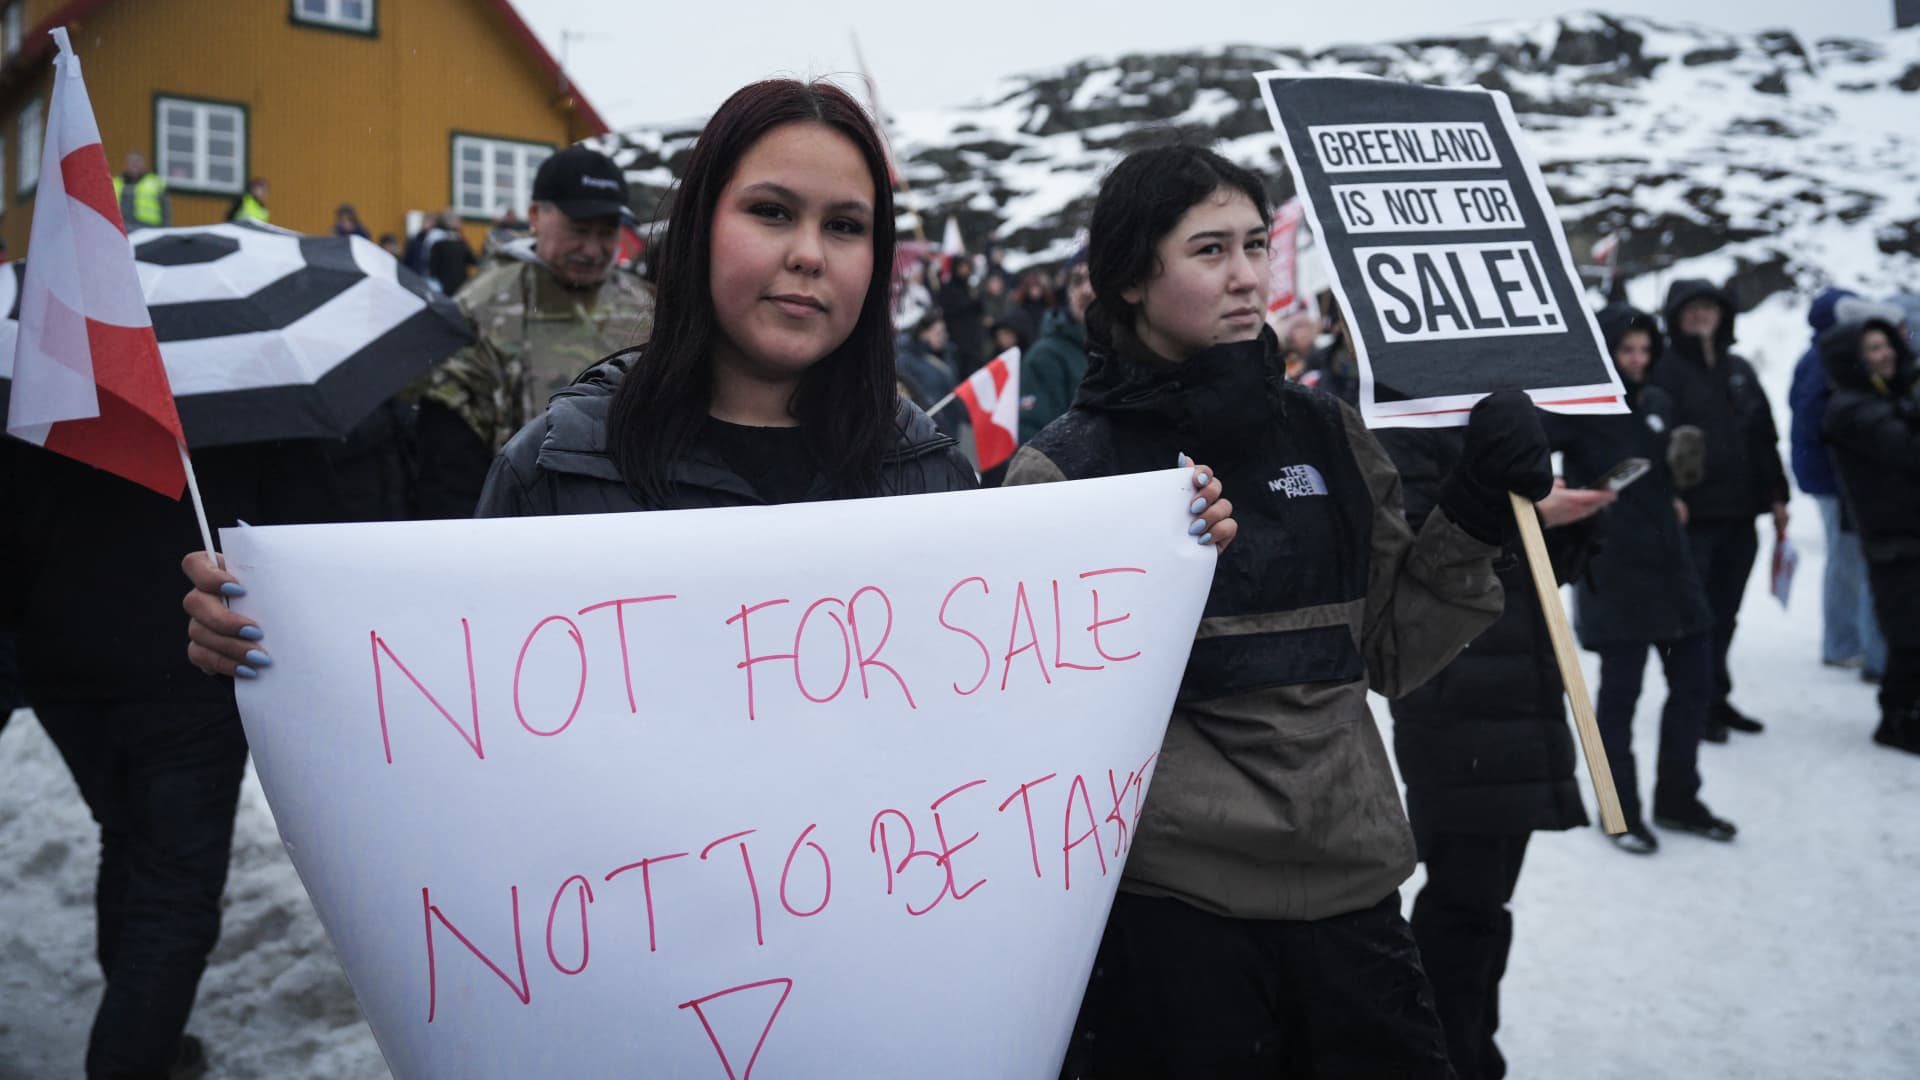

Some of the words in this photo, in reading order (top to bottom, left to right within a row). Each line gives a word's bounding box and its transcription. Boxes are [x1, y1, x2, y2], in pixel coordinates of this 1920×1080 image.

[1318, 128, 1492, 166] GREENLAND
[1339, 190, 1375, 226] IS
[1382, 188, 1443, 225] NOT
[1453, 186, 1517, 224] FOR
[1366, 248, 1559, 335] SALE!
[1267, 475, 1311, 492] NORTH
[1280, 464, 1306, 477] THE
[1285, 486, 1314, 498] FACE
[370, 594, 677, 764] NOT
[725, 584, 917, 721] FOR
[939, 567, 1147, 696] SALE
[422, 852, 688, 1022] NOT
[700, 823, 832, 946] TO
[870, 779, 987, 917] BE
